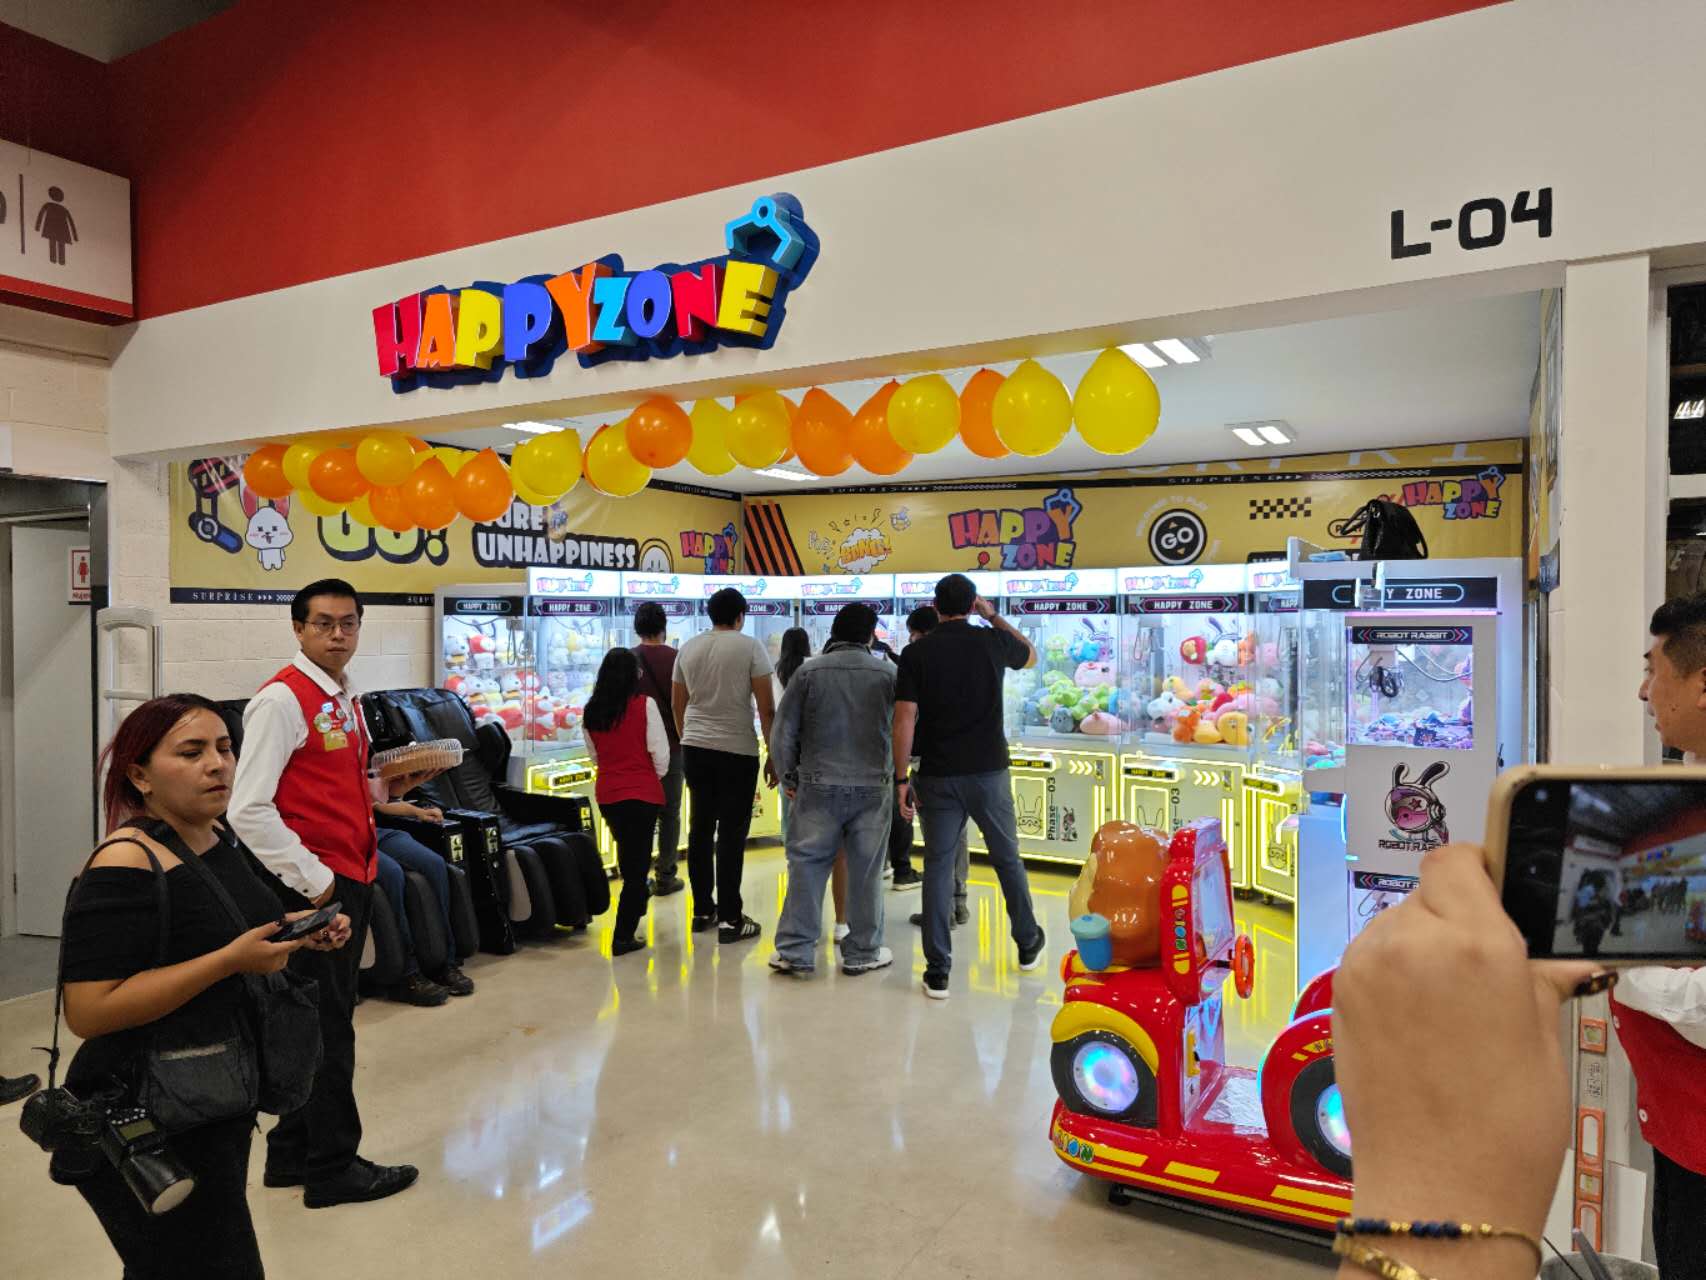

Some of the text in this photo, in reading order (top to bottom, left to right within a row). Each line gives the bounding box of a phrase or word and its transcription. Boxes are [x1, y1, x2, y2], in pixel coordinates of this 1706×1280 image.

[1391, 187, 1552, 260] L-04
[1402, 476, 1500, 507] HAPPY
[1443, 500, 1502, 520] ZONE
[482, 502, 544, 530] URE
[949, 503, 1074, 549] HAPPY
[1160, 526, 1194, 550] GO
[477, 532, 636, 568] UNHAPPINESS
[1001, 542, 1075, 569] ZONE
[192, 592, 254, 601] SURPRISE
[1406, 588, 1442, 599] ZONE
[463, 603, 482, 611] HAPPY
[549, 604, 570, 612] HAPPY
[749, 604, 768, 613] ZONE
[1034, 602, 1088, 611] HAPPY ZONE
[1154, 601, 1213, 610] HAPPY ZONE
[1280, 599, 1298, 608] HAPP
[1410, 632, 1448, 640] RABBIT
[1379, 839, 1411, 850] ROBOT
